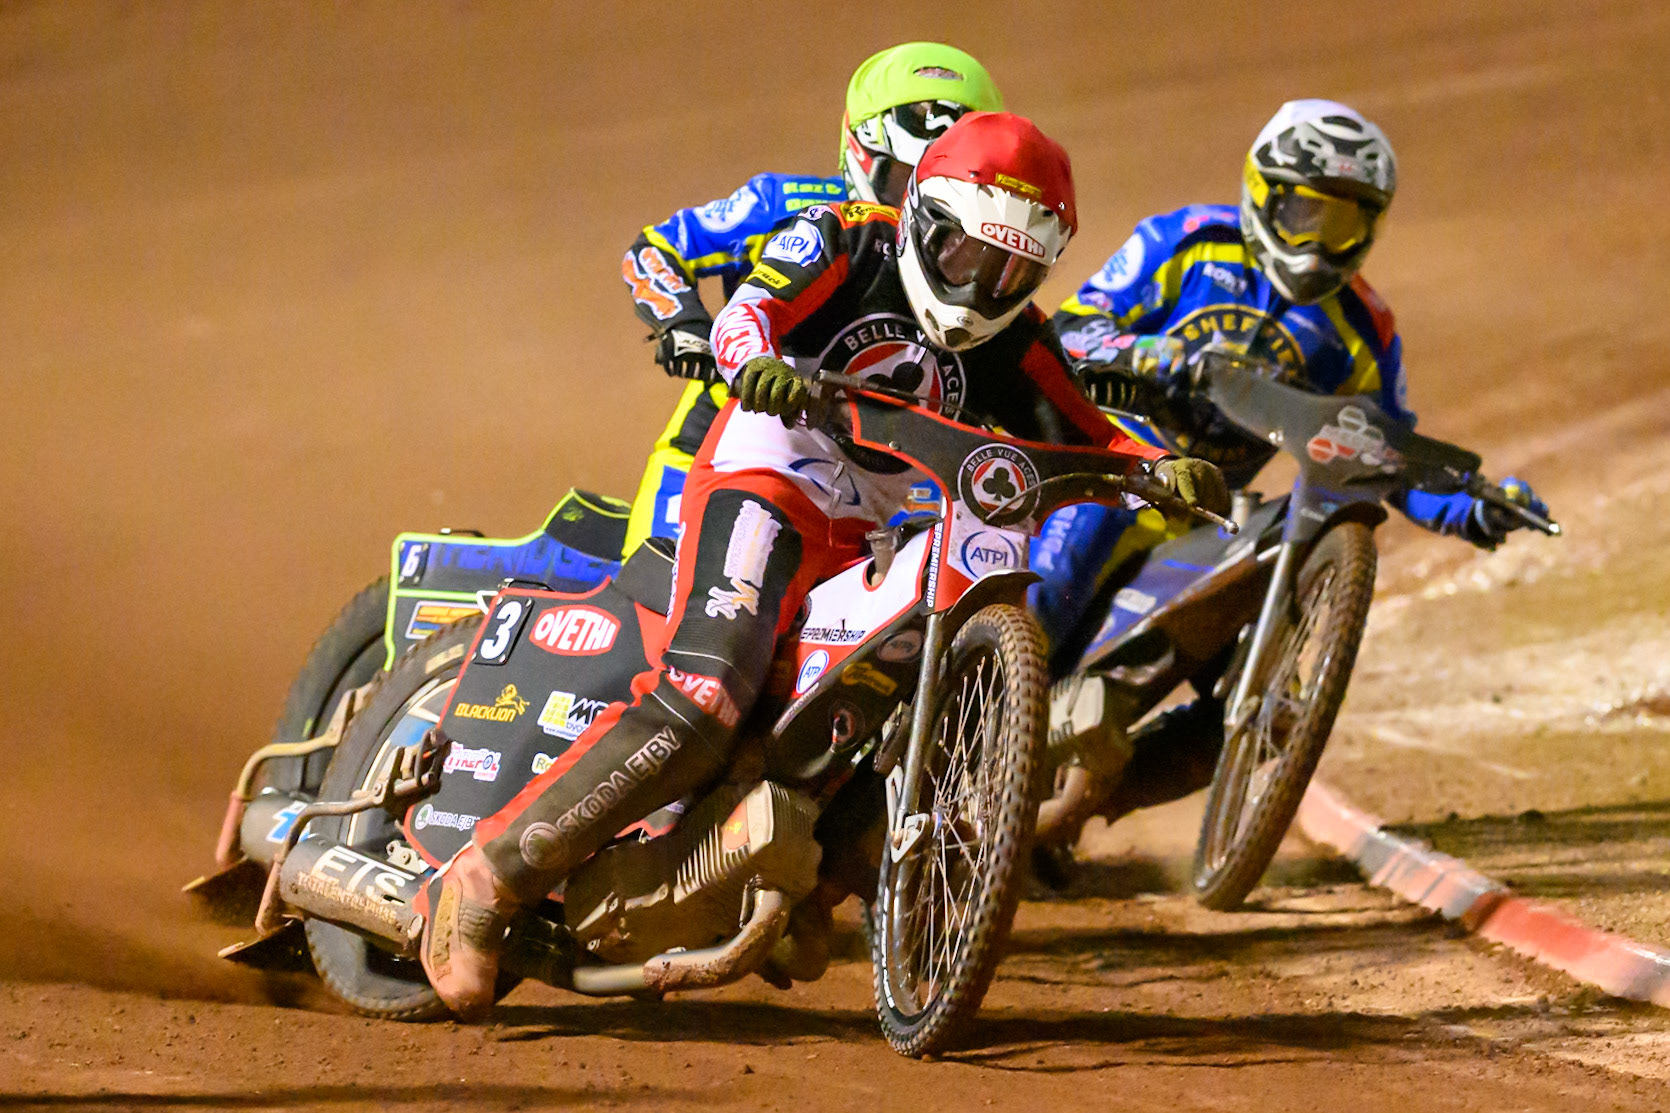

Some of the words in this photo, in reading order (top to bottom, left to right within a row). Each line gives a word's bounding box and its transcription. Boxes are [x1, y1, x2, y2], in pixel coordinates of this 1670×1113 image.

[982, 223, 1044, 255] OVETHI
[844, 322, 906, 351] BELLE
[966, 448, 993, 473] BELLE
[997, 448, 1018, 462] VUE
[970, 547, 1009, 566] ATPI
[480, 600, 522, 660] 3
[534, 609, 617, 652] OVETHI
[454, 702, 517, 723] BLACKLION
[556, 770, 636, 836] SKODA
[311, 845, 416, 906] ETS
